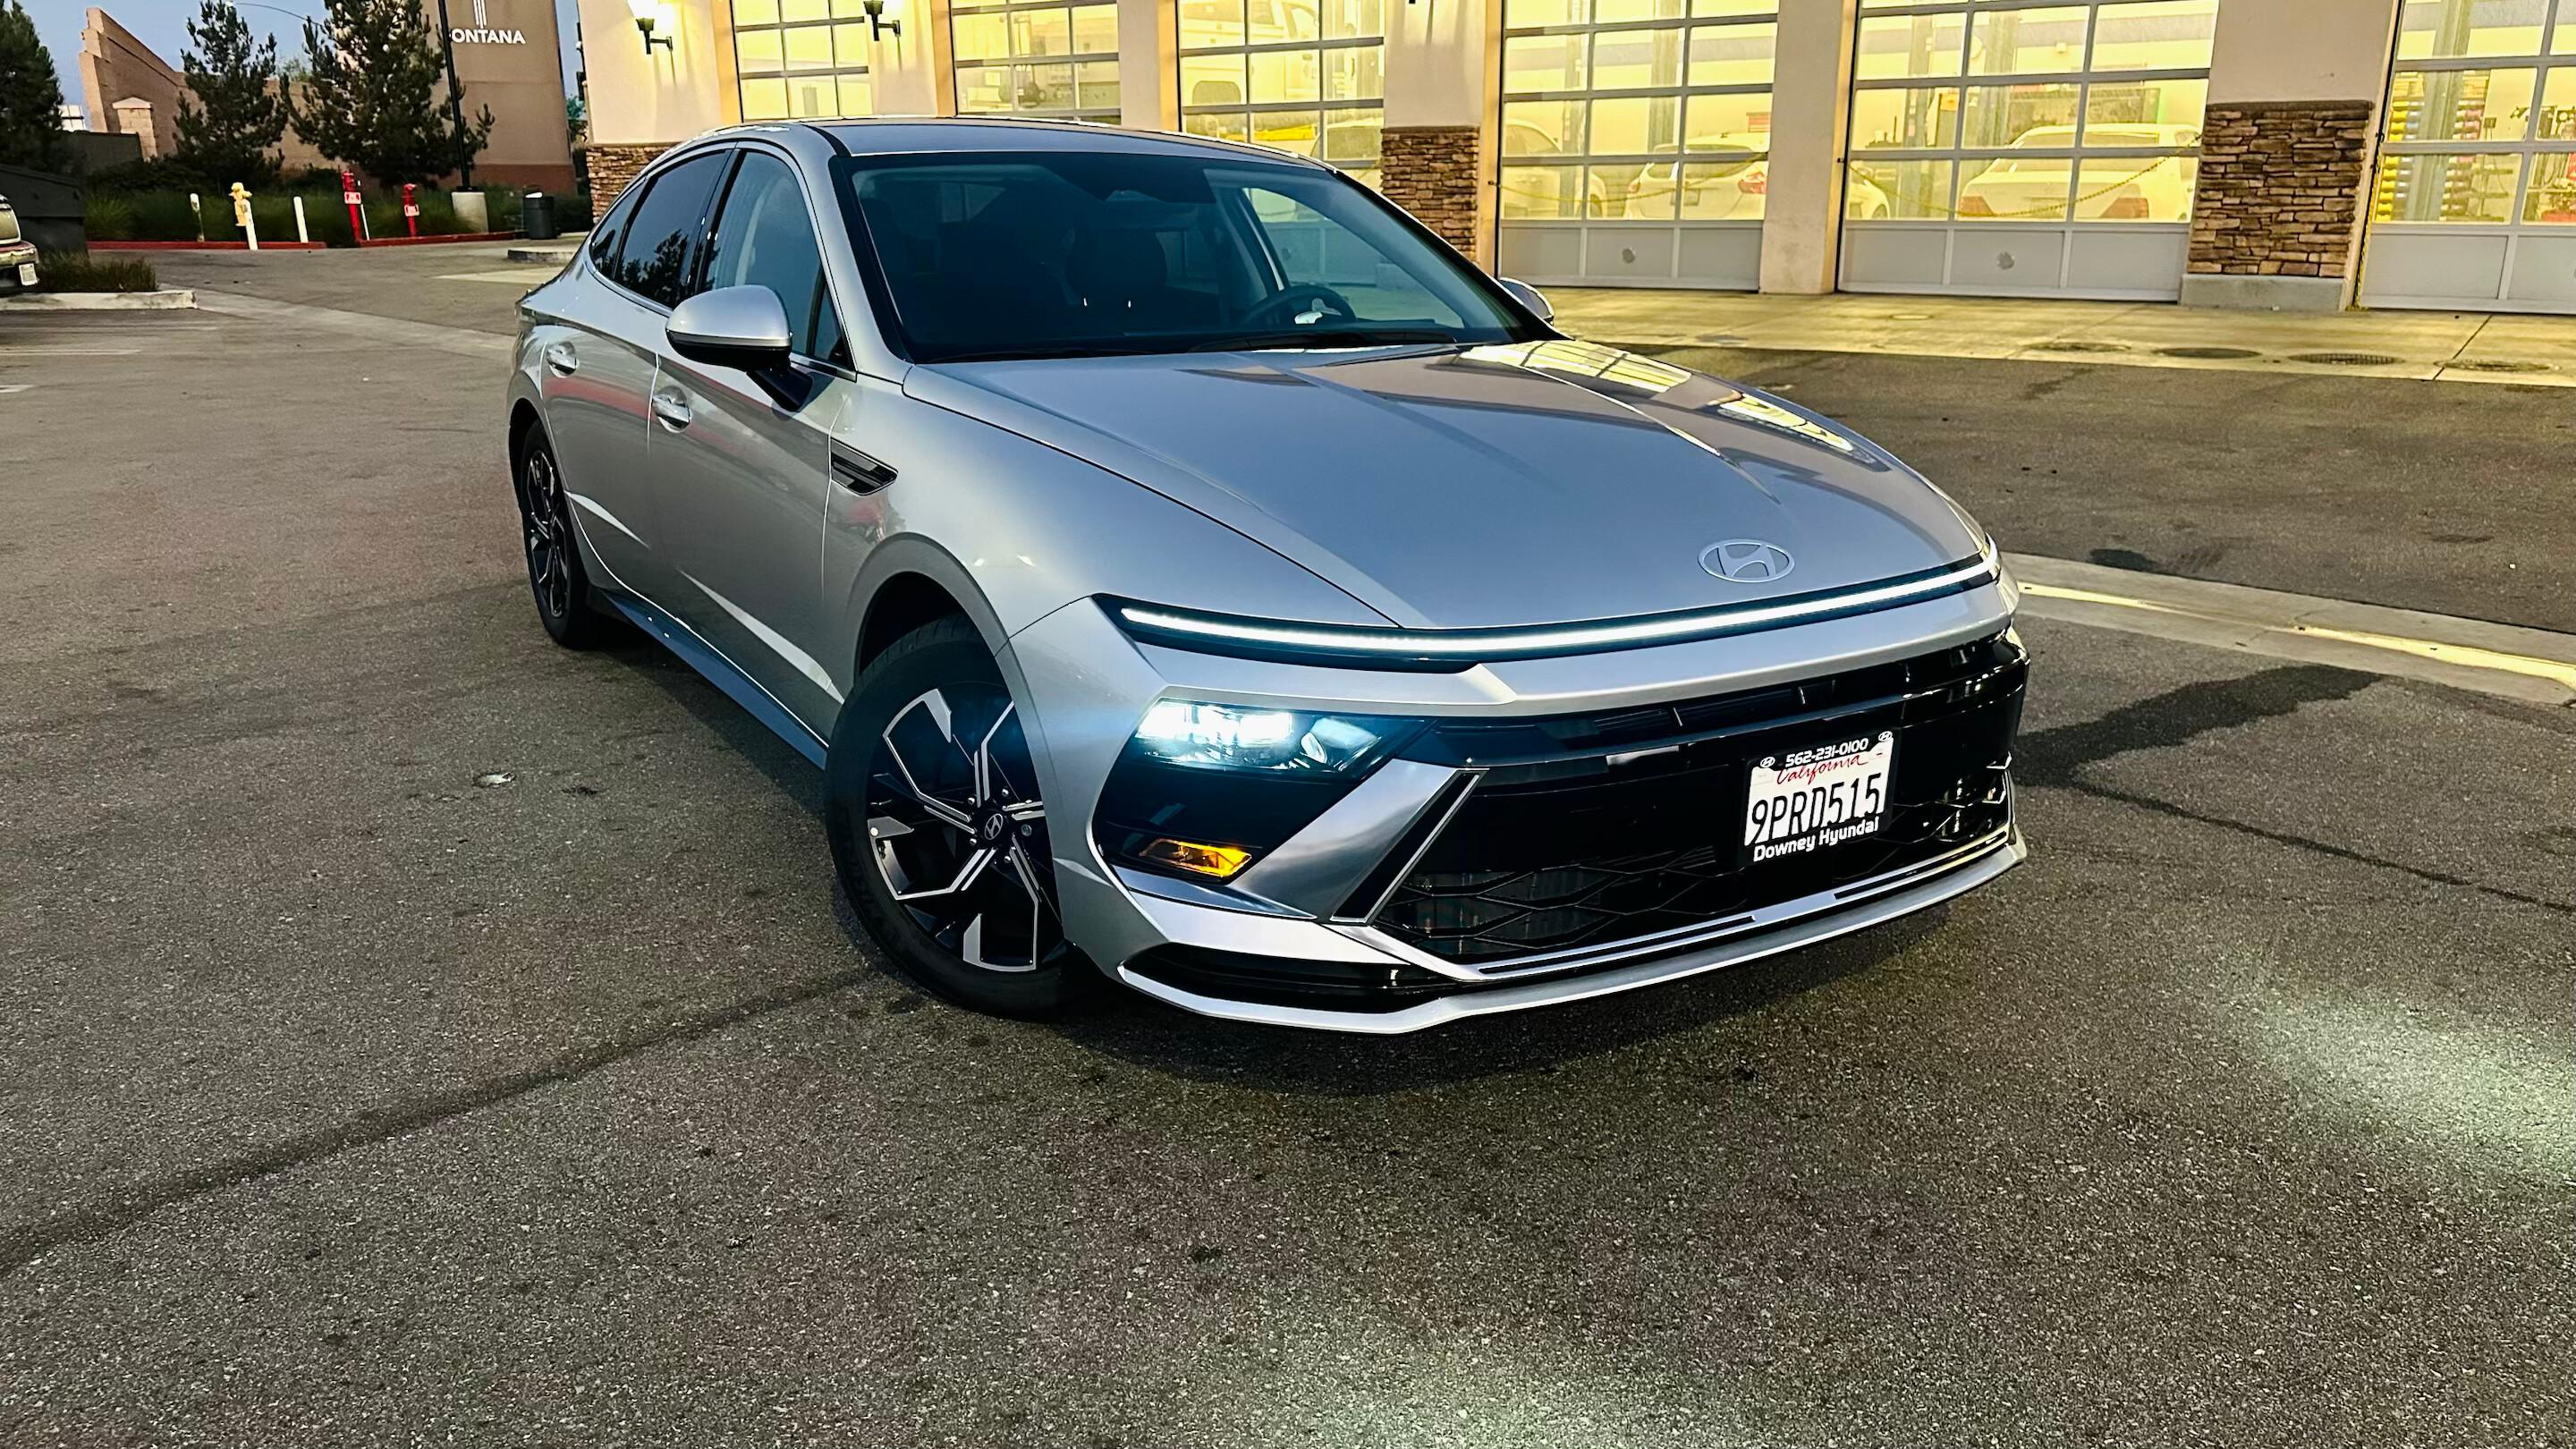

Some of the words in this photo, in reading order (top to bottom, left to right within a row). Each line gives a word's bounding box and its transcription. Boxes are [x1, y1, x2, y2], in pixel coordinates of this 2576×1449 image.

[448, 28, 527, 45] ONTANA
[1784, 738, 1869, 767] 562-231-0100
[1776, 755, 1869, 784] California
[1750, 773, 1882, 843] 9PRD515
[1753, 834, 1817, 862] Downey
[1818, 815, 1880, 846] Hyundai
